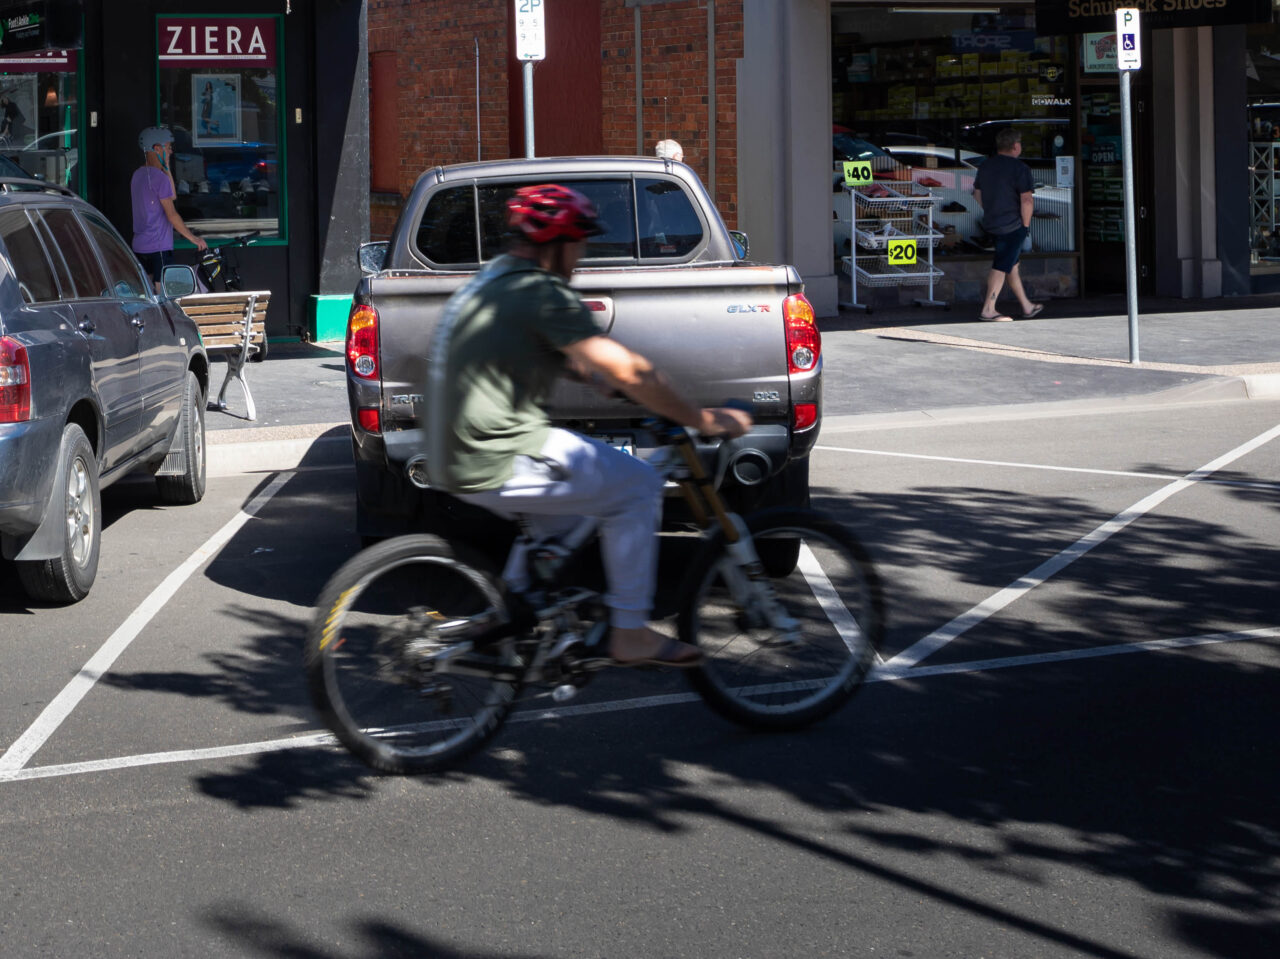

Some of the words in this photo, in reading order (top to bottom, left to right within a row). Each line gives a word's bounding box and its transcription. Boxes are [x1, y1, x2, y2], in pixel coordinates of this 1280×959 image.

[166, 26, 267, 54] ZIERA
[847, 166, 871, 182] $40
[889, 244, 915, 260] $20
